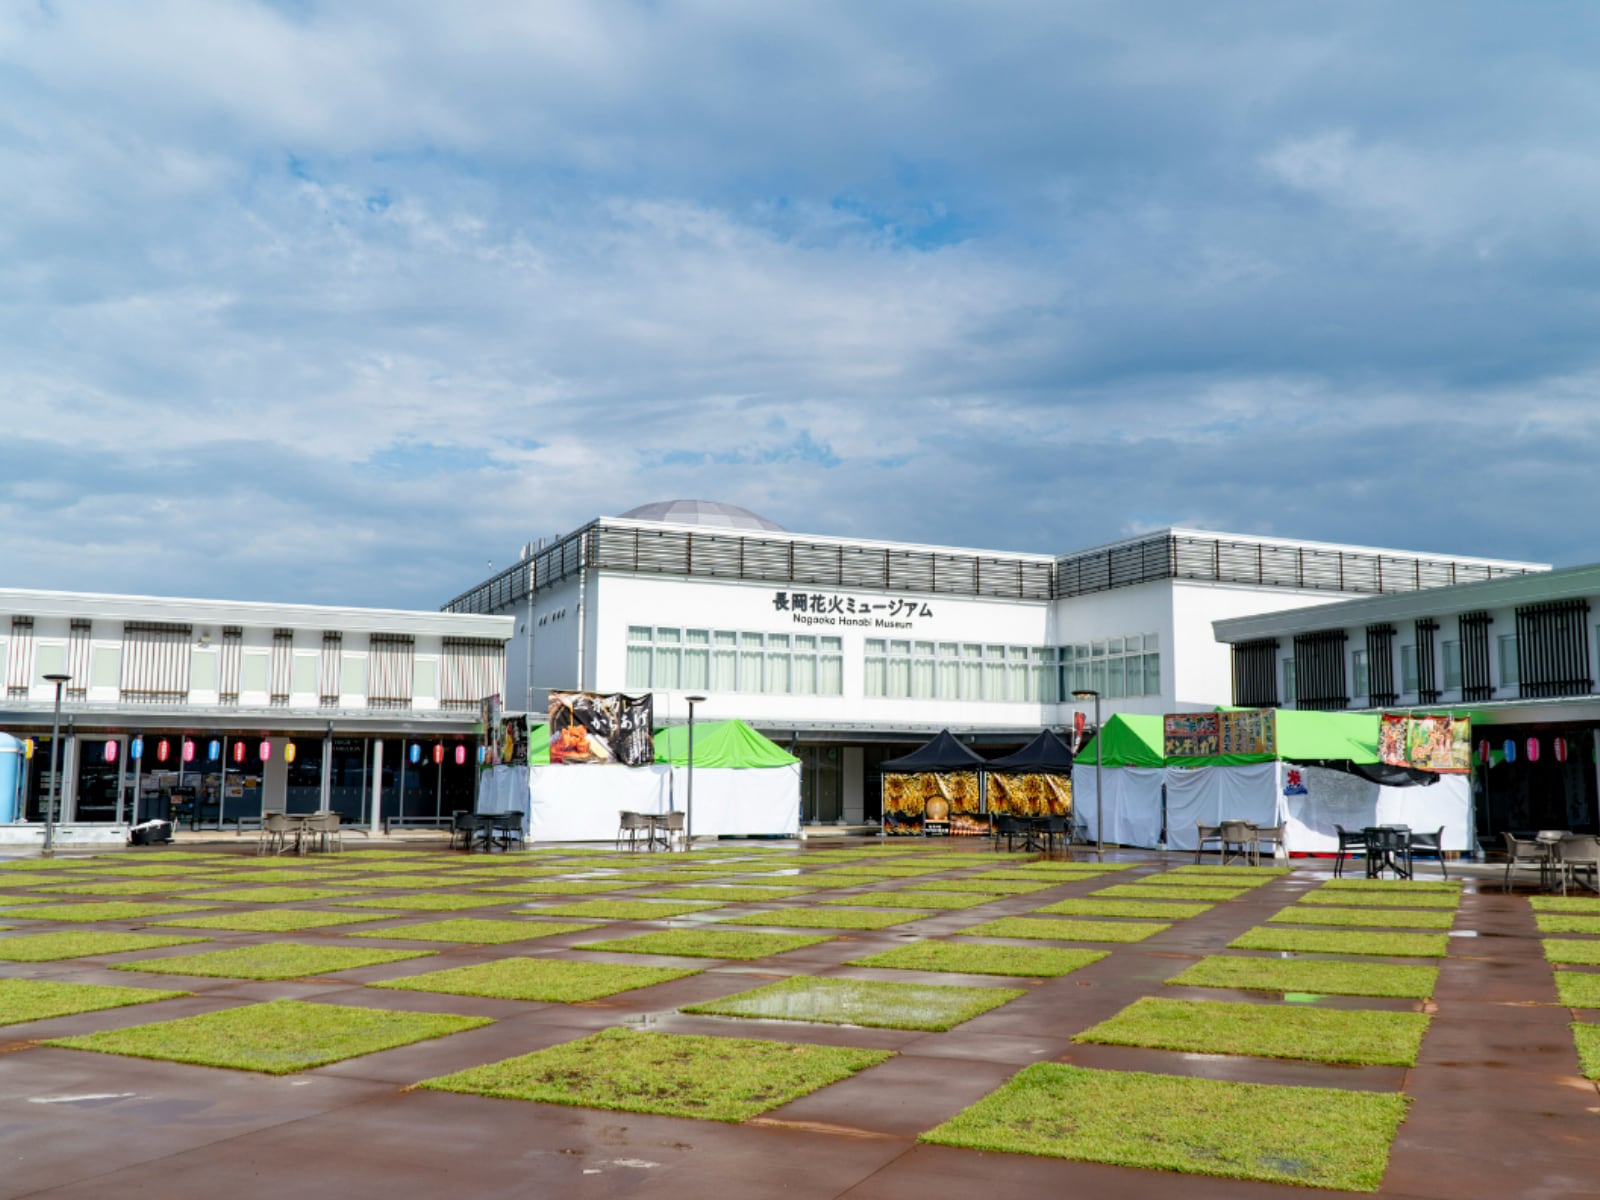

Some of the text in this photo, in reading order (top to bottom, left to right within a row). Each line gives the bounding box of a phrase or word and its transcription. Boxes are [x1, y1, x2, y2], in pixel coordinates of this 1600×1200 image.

[772, 592, 933, 618] 長岡花火ミュージアム
[793, 614, 913, 629] Nagaoka Hanabi Museum
[591, 708, 649, 731] からあげ
